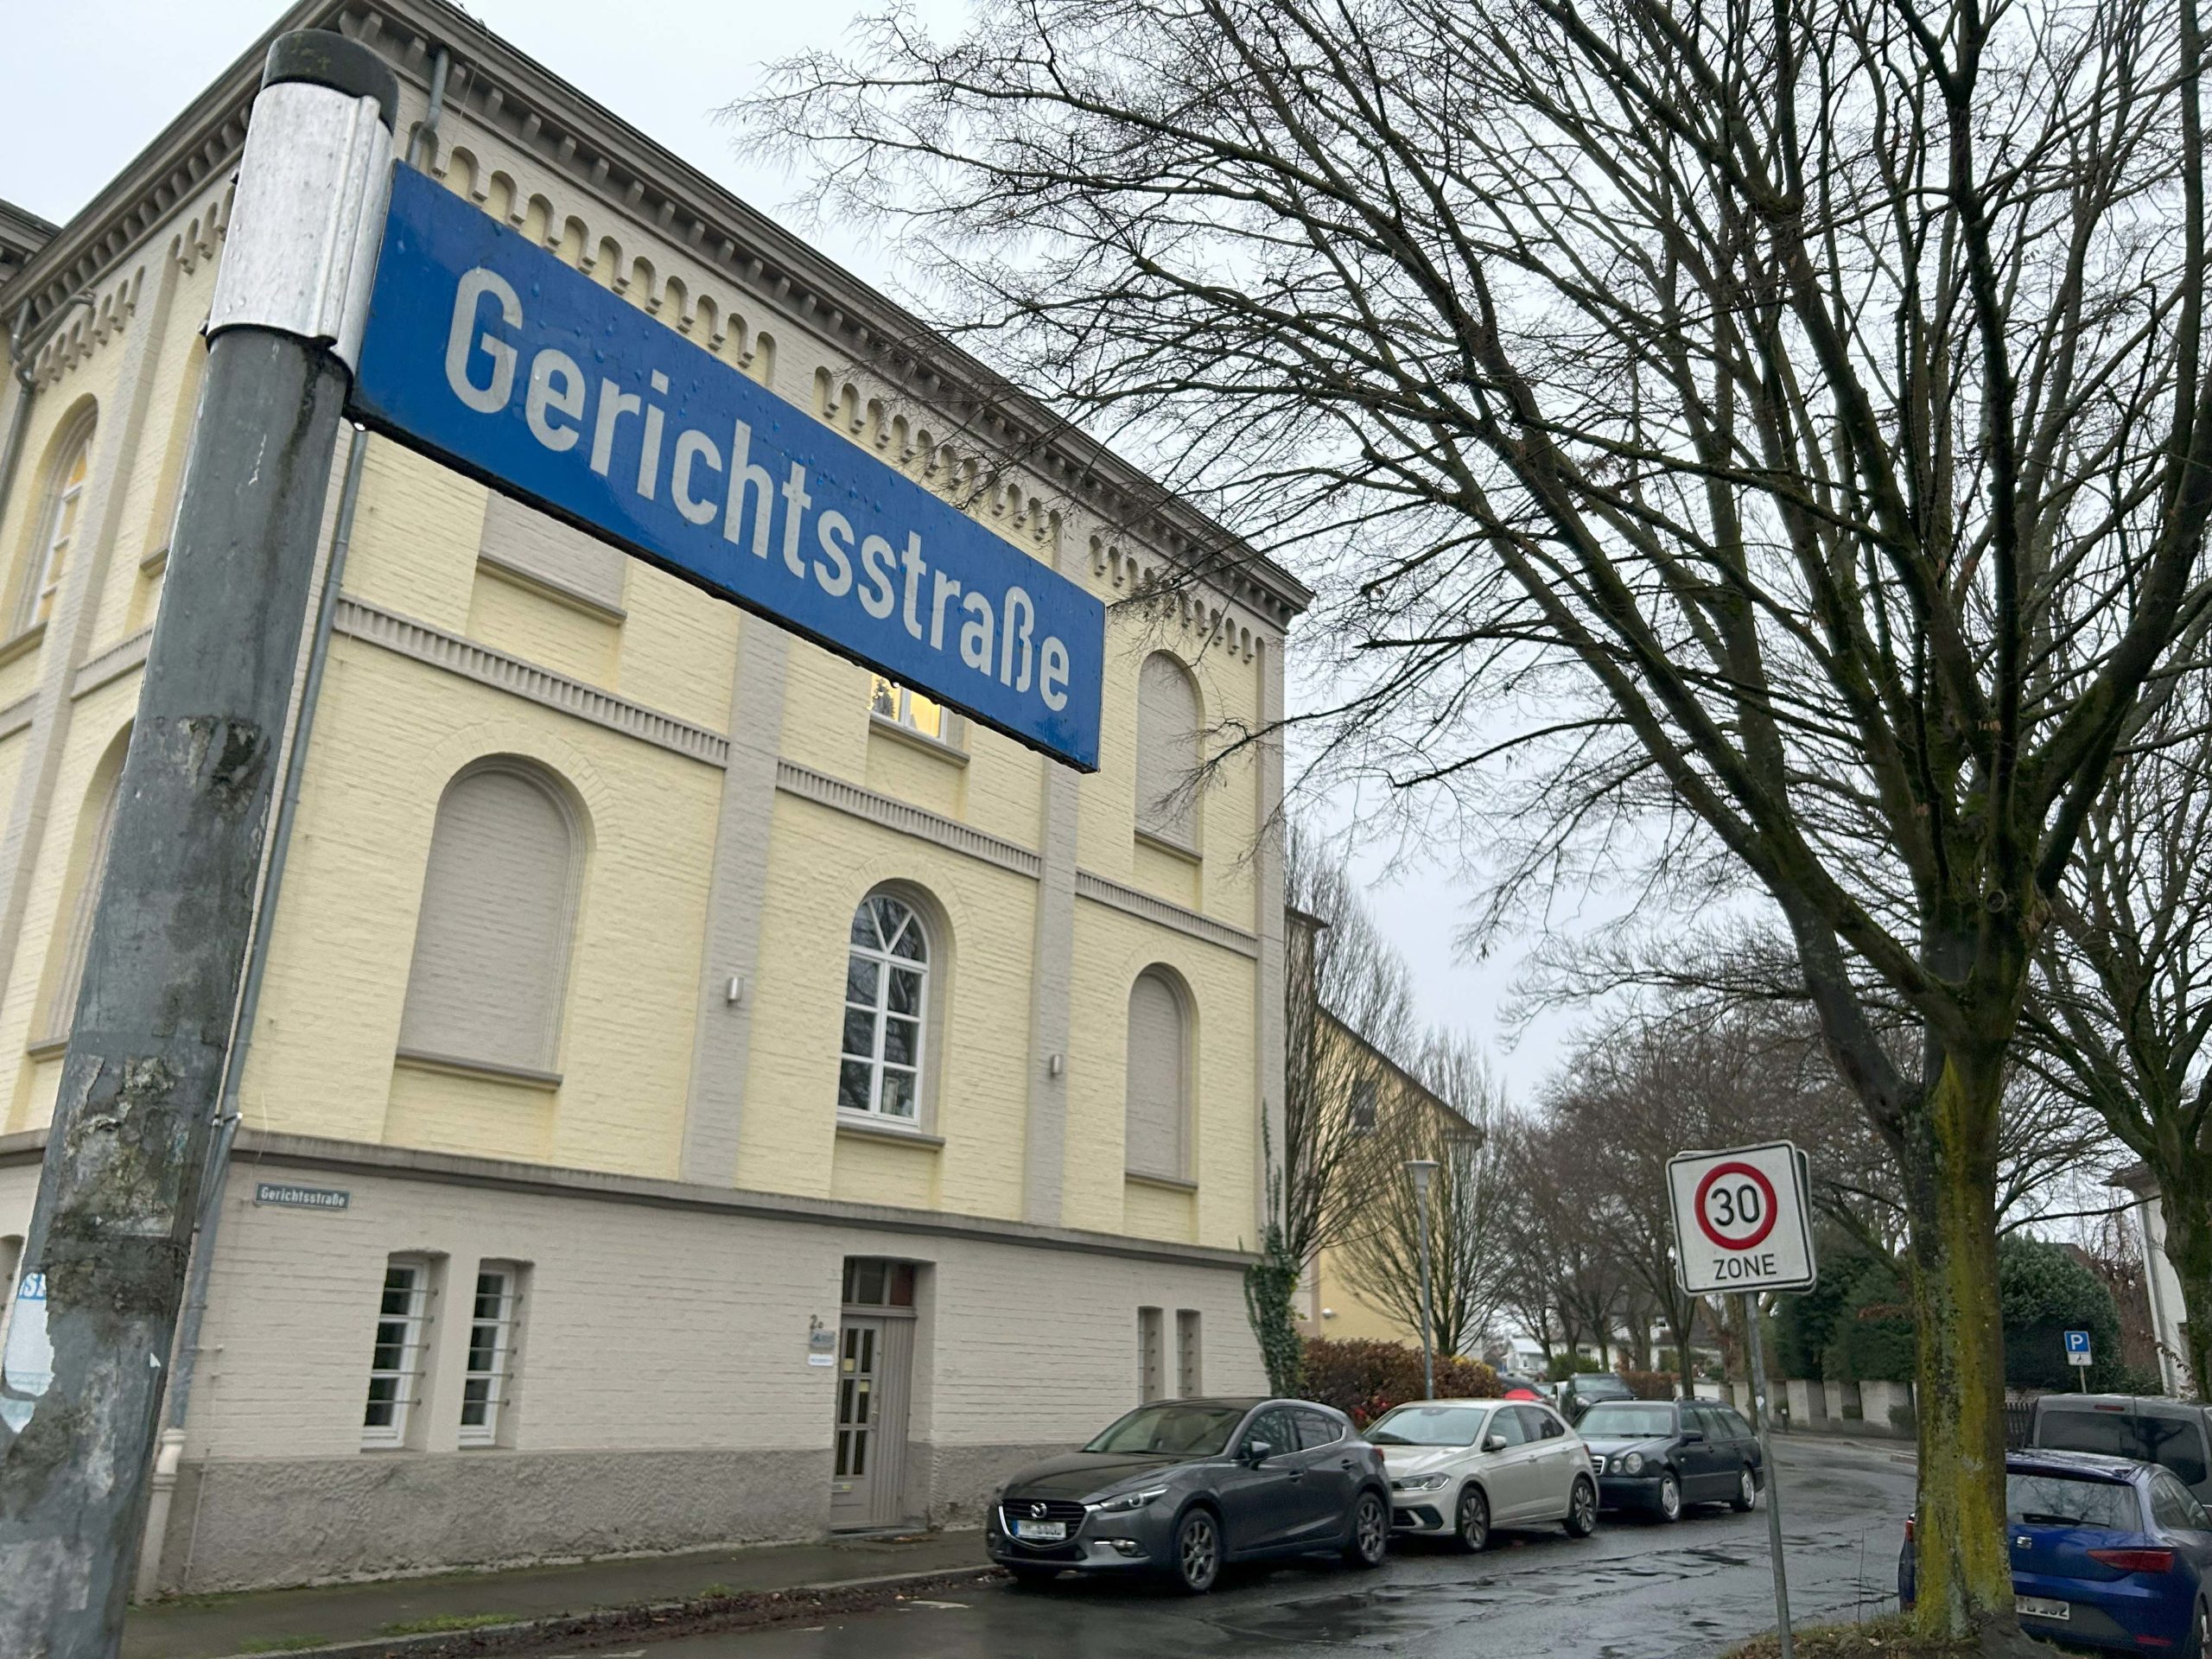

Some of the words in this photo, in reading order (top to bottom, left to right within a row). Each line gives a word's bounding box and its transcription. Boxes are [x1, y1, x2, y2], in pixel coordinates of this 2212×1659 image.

[445, 267, 1071, 712] Gerichtsstraße
[260, 1185, 346, 1207] Gerichtsstraße
[1711, 1184, 1760, 1226] 30
[1713, 1253, 1777, 1281] ZONE
[2070, 1333, 2084, 1351] P
